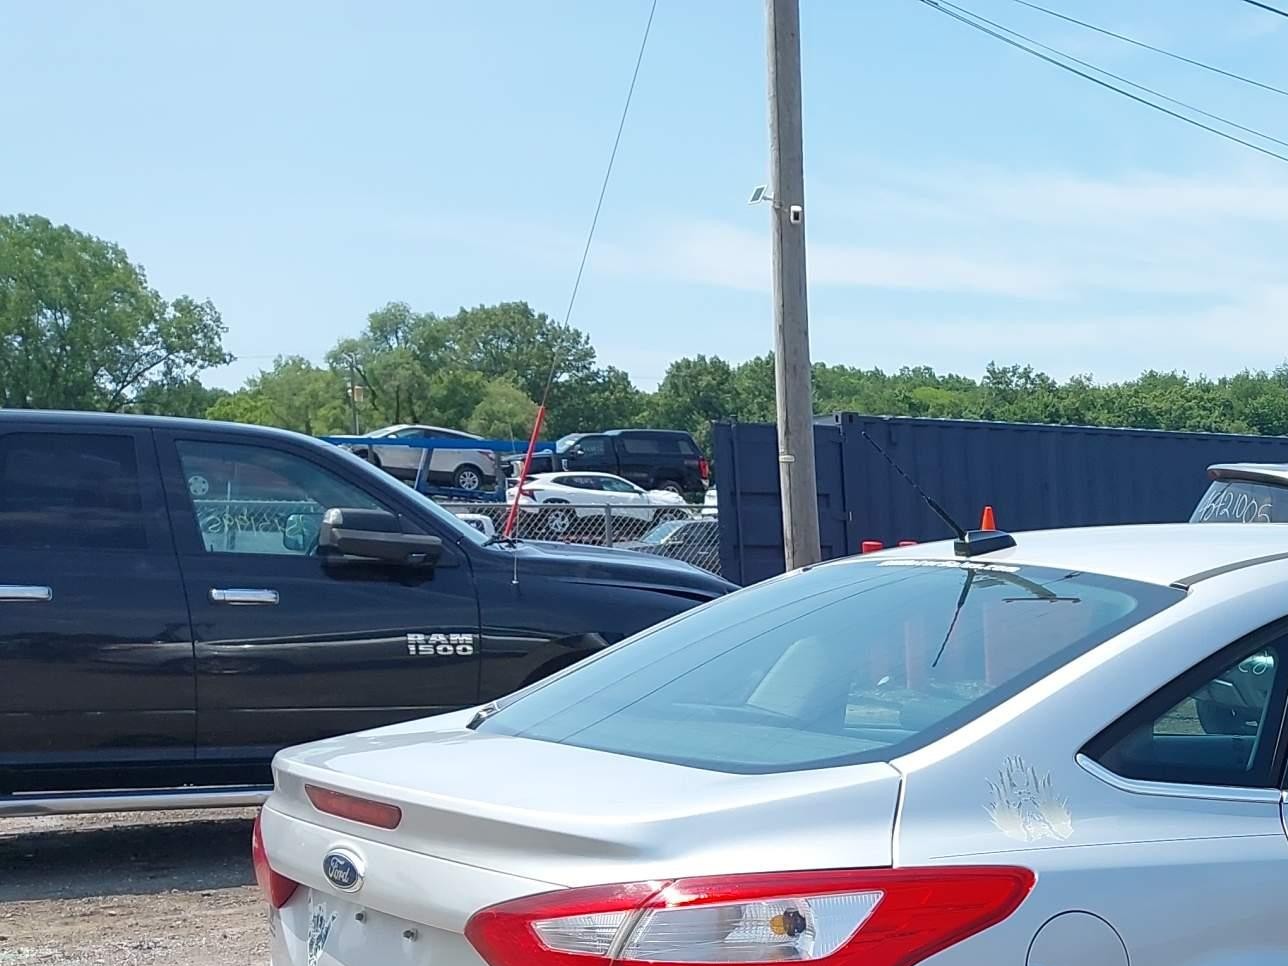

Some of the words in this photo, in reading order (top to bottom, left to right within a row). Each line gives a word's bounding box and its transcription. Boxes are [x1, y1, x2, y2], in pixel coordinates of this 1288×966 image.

[407, 633, 473, 644] RAM
[407, 644, 474, 655] 1500
[328, 856, 352, 884] Ford
